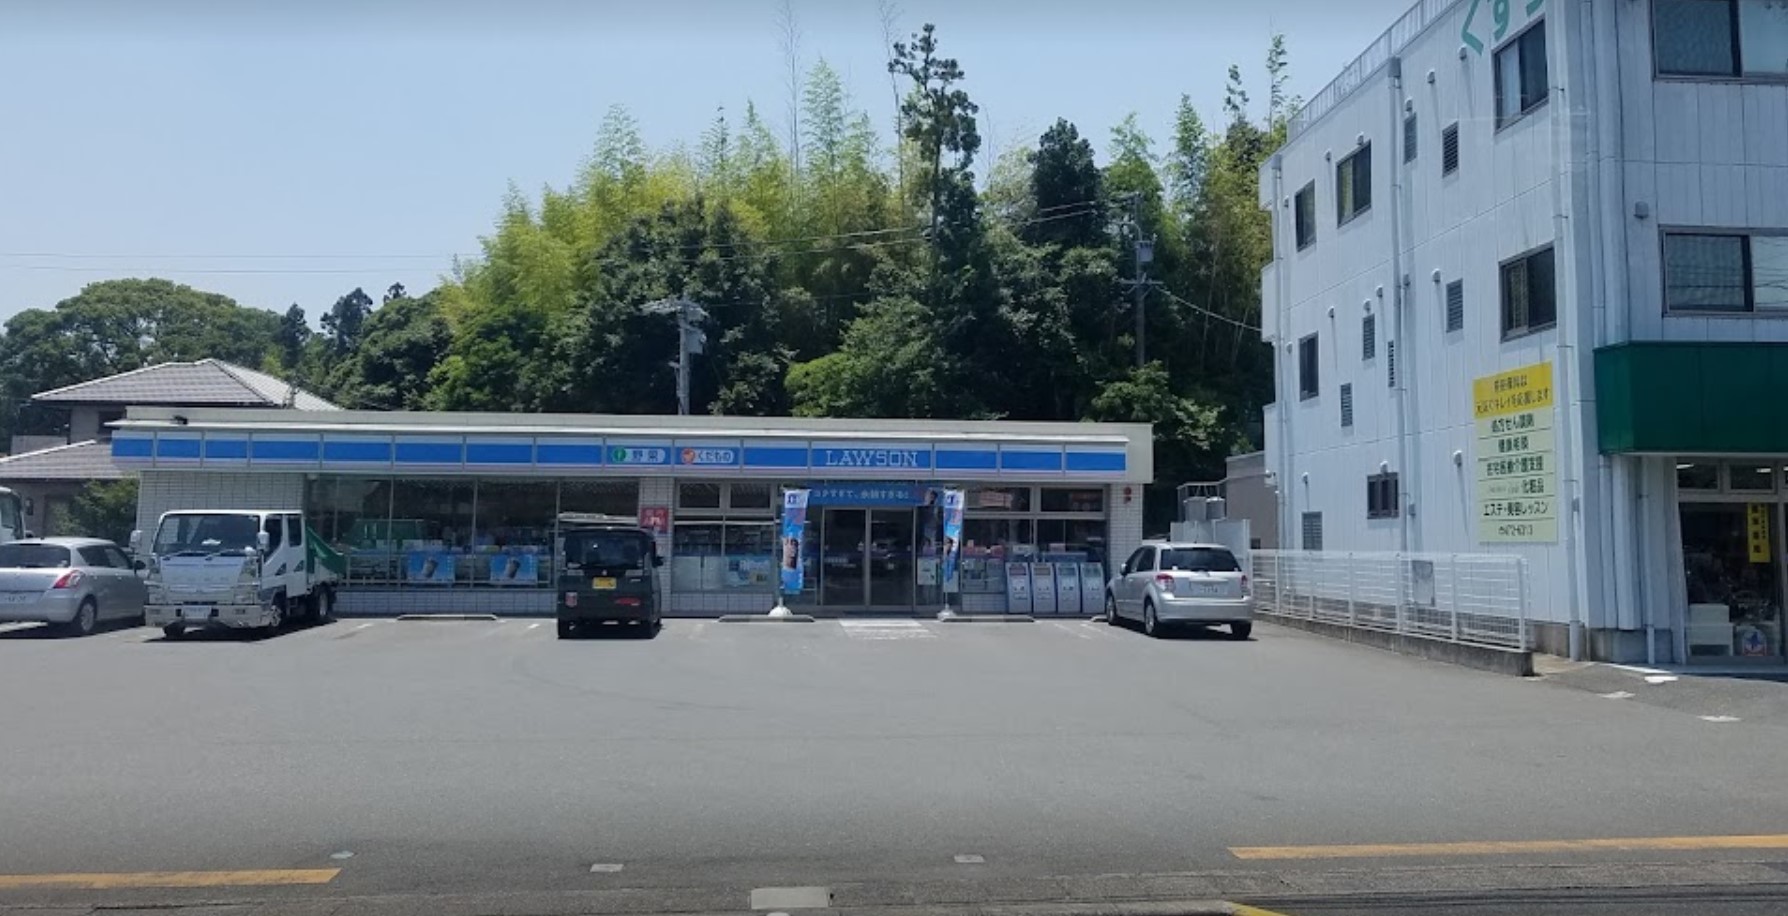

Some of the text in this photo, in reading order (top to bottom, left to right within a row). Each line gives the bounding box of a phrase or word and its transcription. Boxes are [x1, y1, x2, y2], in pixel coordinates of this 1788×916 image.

[1492, 414, 1534, 432] 処方せん調剤
[1498, 436, 1529, 452] 健康相談
[632, 449, 658, 461] 野菜
[698, 449, 732, 460] くだもの
[826, 450, 918, 467] LAWSON
[1522, 478, 1544, 493] 化粧品
